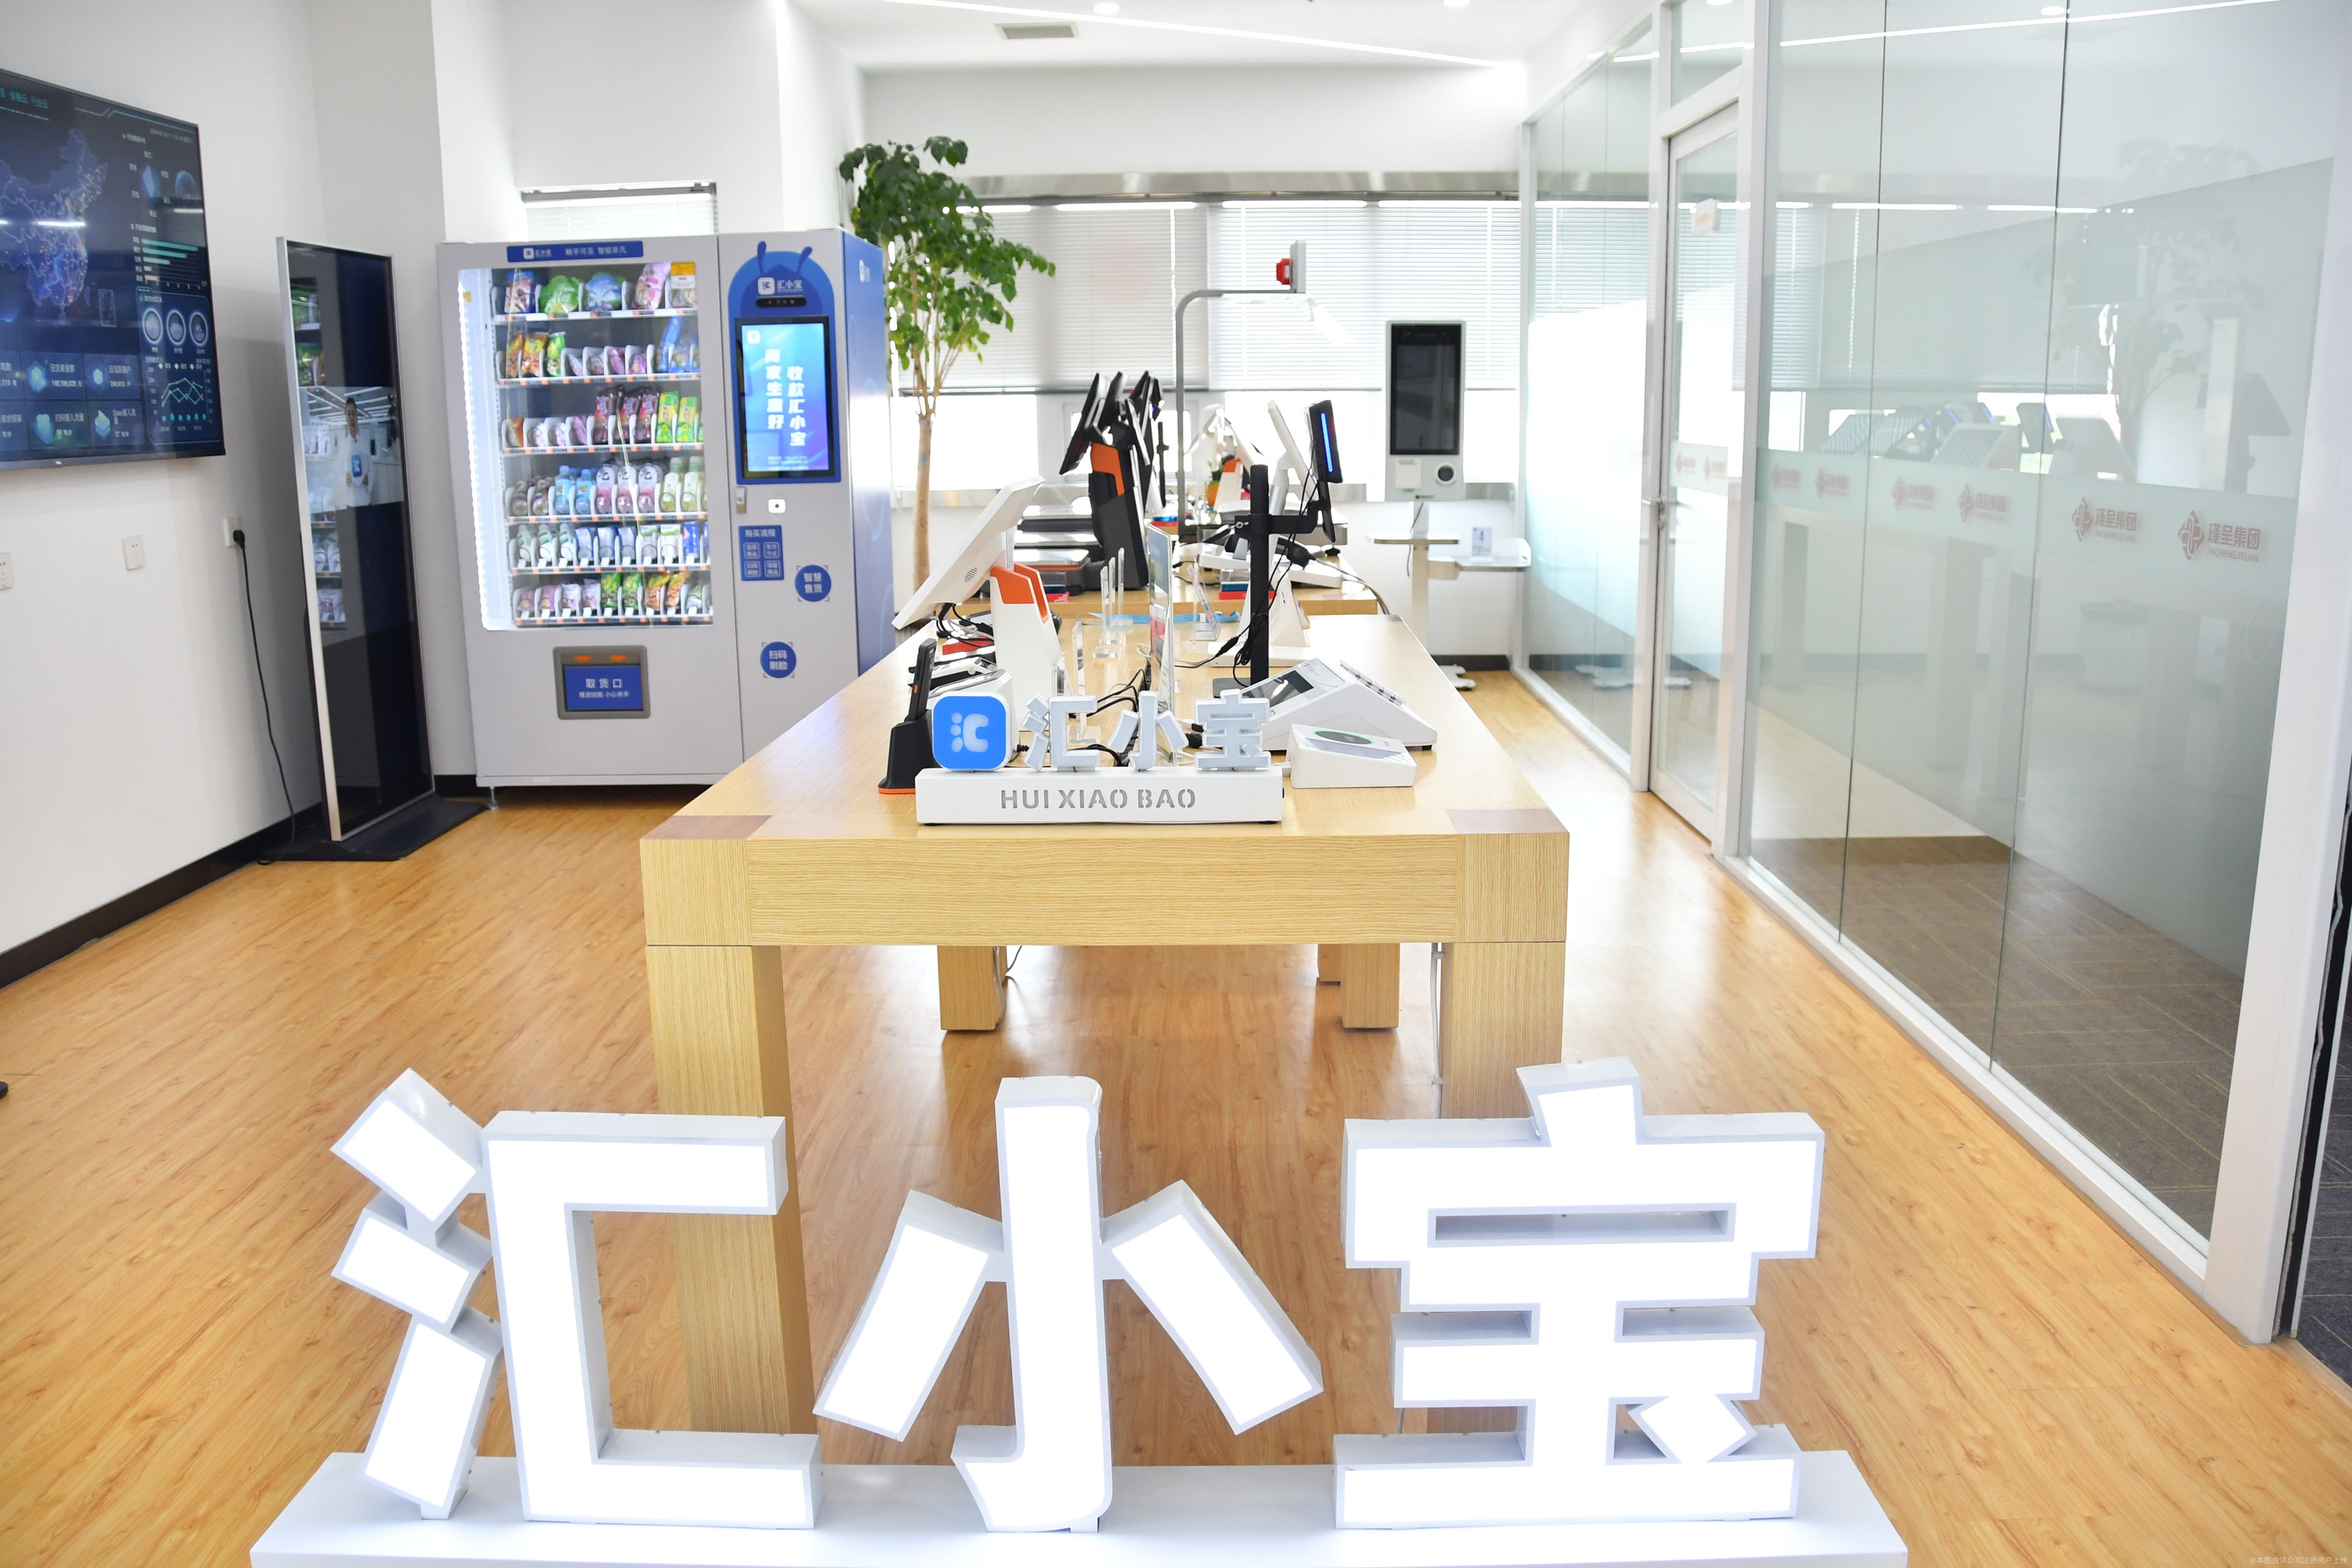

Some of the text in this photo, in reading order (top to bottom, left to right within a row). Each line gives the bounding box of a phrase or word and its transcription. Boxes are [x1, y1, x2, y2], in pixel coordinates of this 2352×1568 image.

[776, 279, 803, 289] 汇小宝
[765, 348, 784, 430] 商家生意好
[787, 365, 807, 447] 收款汇小宝
[2095, 508, 2138, 531] 瑾呈集团
[2208, 522, 2261, 550] 瑾呈集团
[2206, 548, 2259, 563] JINCHENGJITUAN
[803, 572, 822, 583] 智慧
[803, 583, 823, 594] 售货
[769, 649, 787, 660] 扫码
[769, 660, 788, 671] 刷脸
[585, 678, 623, 689] 取货口
[1021, 689, 1271, 771] 汇小宝
[1000, 789, 1196, 809] HUI XIAO BAO
[331, 1058, 1825, 1533] 汇小宝
